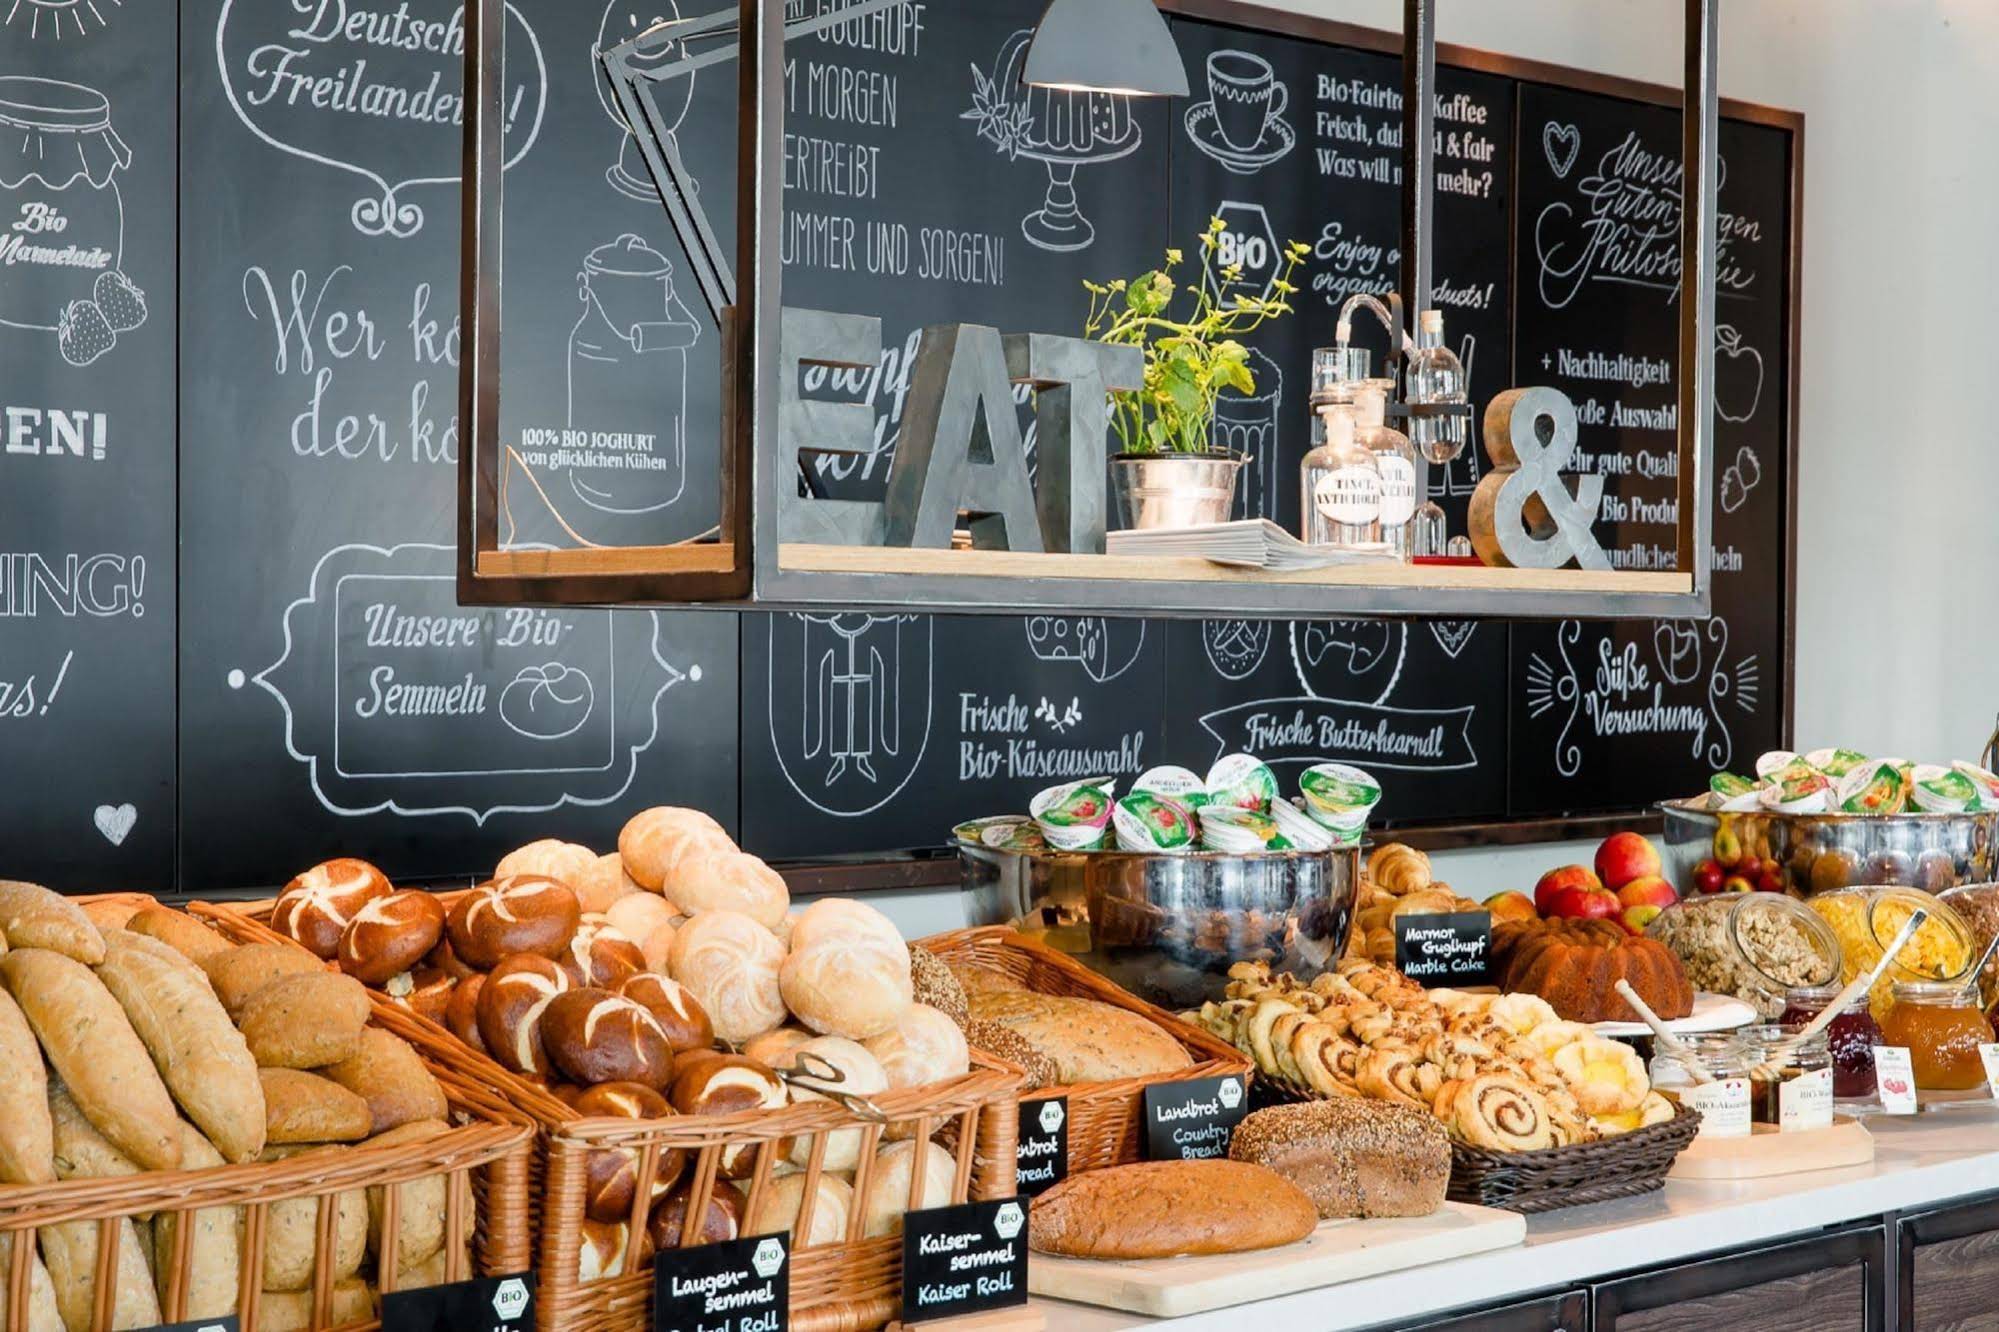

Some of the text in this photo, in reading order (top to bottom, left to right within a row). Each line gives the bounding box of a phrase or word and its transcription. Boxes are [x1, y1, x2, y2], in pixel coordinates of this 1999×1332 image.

[808, 61, 897, 129] MORGEN
[1316, 111, 1373, 147] Frisch,
[1447, 132, 1461, 159] &
[1463, 131, 1495, 162] fair
[1316, 147, 1356, 178] Was
[1357, 156, 1390, 183] will
[1437, 168, 1493, 199] mehr?
[12, 202, 68, 234] Bio
[781, 210, 1004, 286] UMMER UND SORGEN!
[1314, 221, 1382, 275] Enjoy
[243, 264, 386, 375] Wer
[1557, 348, 1671, 388] Nachhaltigkeit
[291, 366, 398, 462] der
[778, 306, 1145, 555] EAT
[1610, 400, 1677, 430] Auswahl
[522, 428, 657, 452] 100% BIO JOGHURT
[522, 450, 667, 471] von glücklichen Kühen
[1598, 451, 1632, 477] gute
[1601, 494, 1627, 522] Bio
[364, 603, 574, 649] Unsere Bio-
[1597, 637, 1650, 701] Süße
[355, 665, 486, 718] Semmeln
[960, 693, 1030, 733] Frische
[1584, 681, 1708, 759] Versuchung
[1243, 709, 1313, 753] Frische
[960, 731, 1144, 781] Bio-Käseauswahl
[1405, 928, 1456, 942] Marmor
[1421, 935, 1486, 959] Guglhupf
[1404, 958, 1486, 976] Marble Cake
[1157, 1098, 1219, 1122] Landbrot
[1173, 1123, 1229, 1145] Country
[1181, 1140, 1223, 1160] Bread
[919, 1233, 982, 1256] Kaiser-
[949, 1242, 1016, 1272] semmel
[672, 1270, 748, 1298] Laugen-
[705, 1279, 775, 1314] semmel
[918, 1270, 1014, 1306] Kaiser Roll
[740, 1310, 779, 1332] Roll
